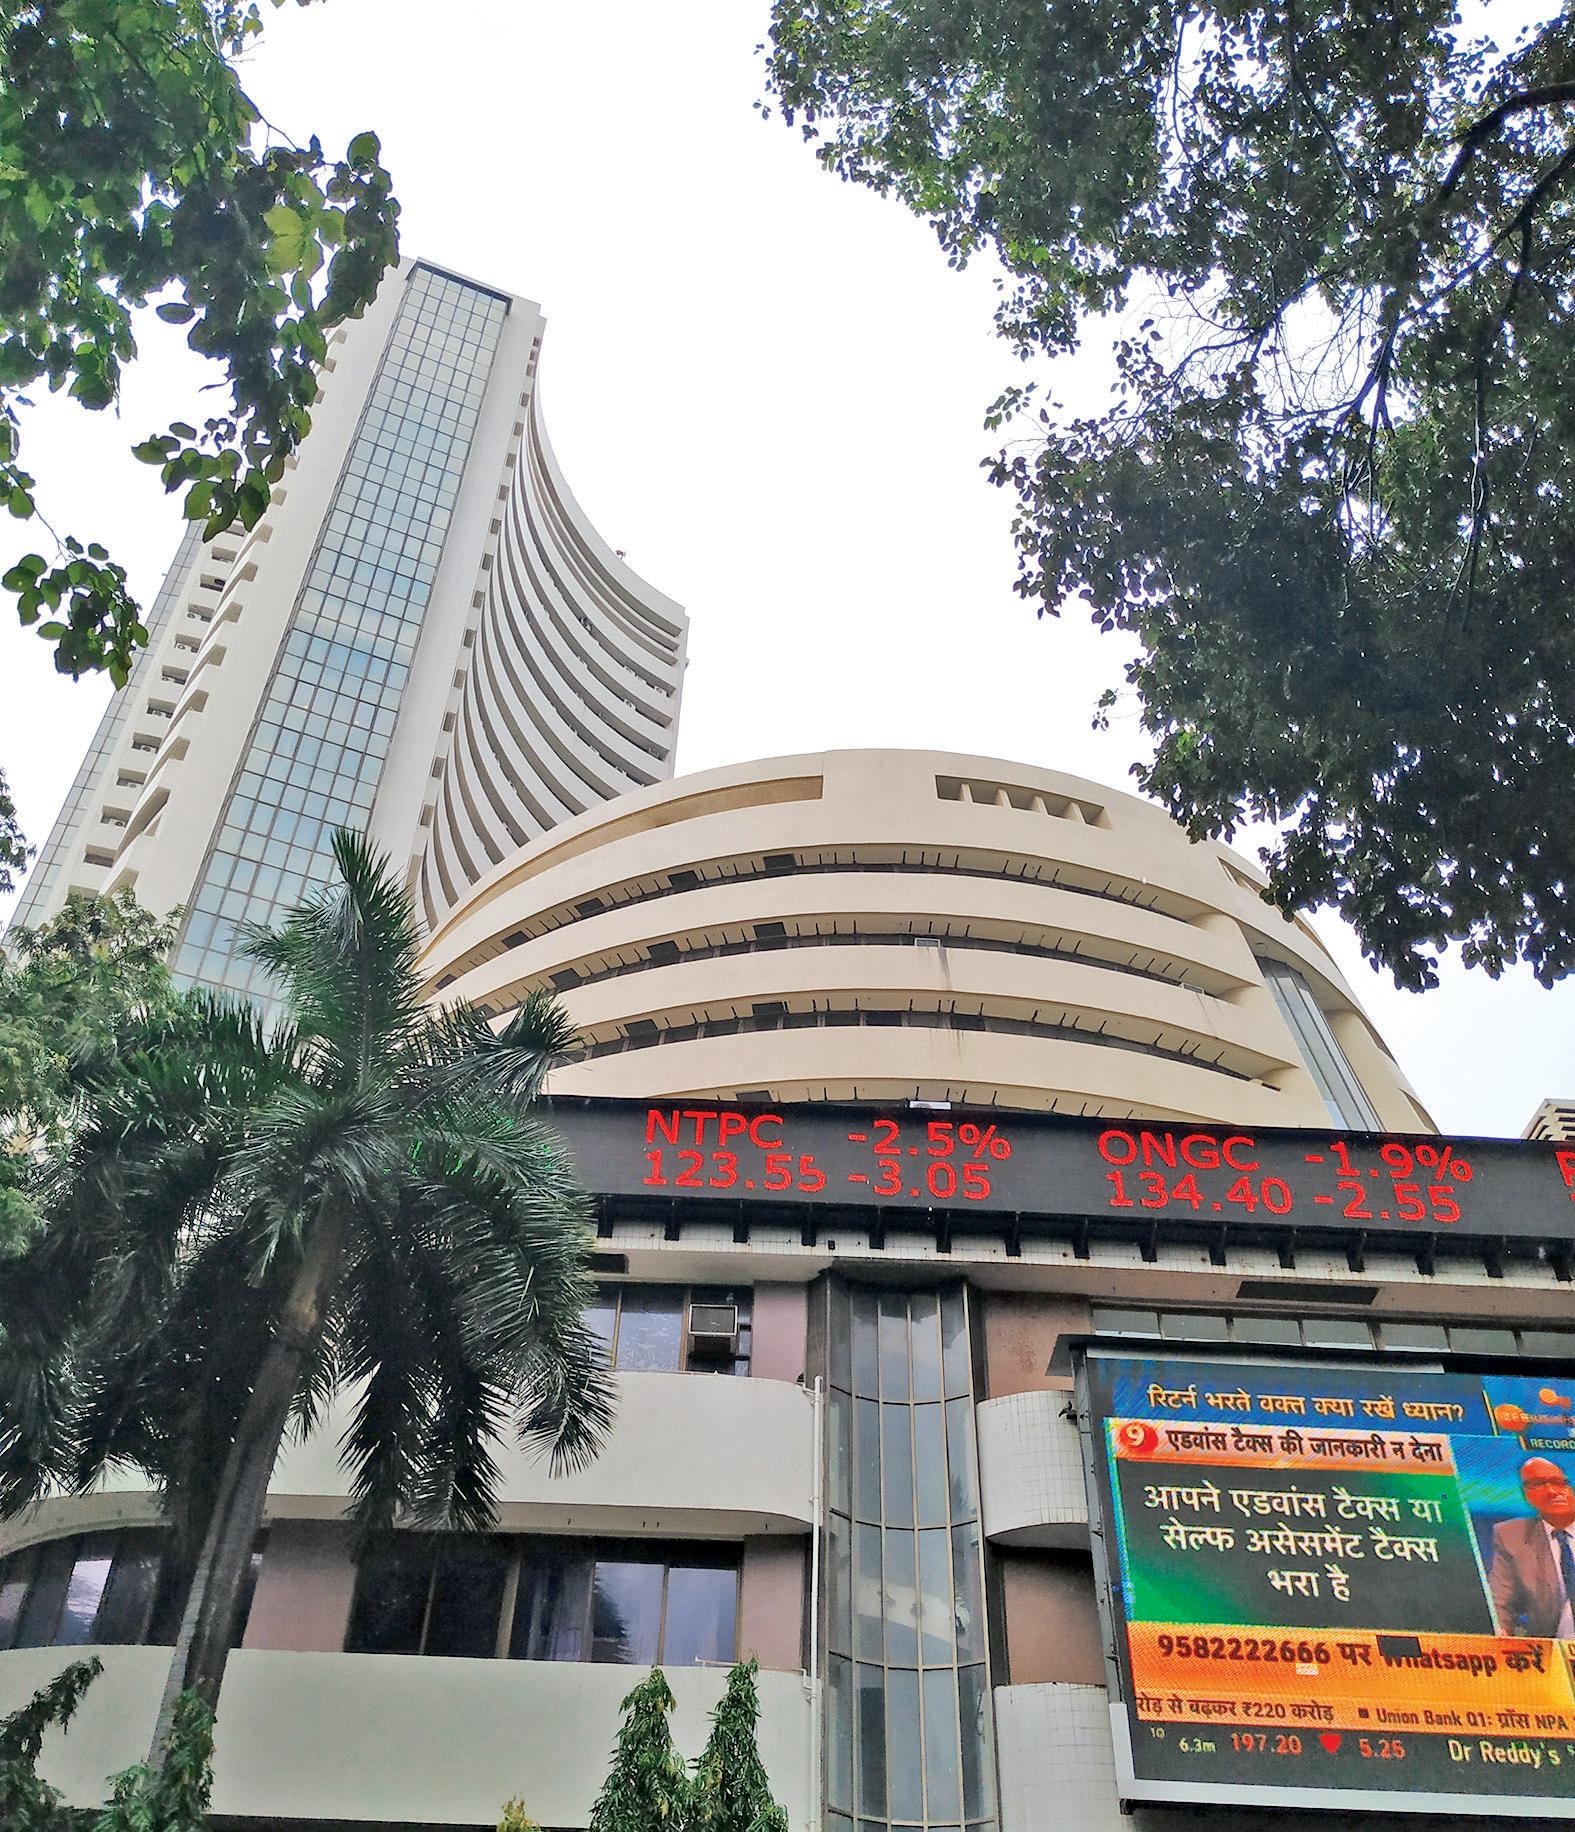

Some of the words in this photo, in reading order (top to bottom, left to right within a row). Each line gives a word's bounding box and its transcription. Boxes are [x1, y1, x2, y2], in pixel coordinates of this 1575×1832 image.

[646, 1109, 784, 1150] NTPC
[848, 1119, 1012, 1161] -2.5%
[1097, 1130, 1262, 1172] ONGC
[1304, 1140, 1473, 1182] -1.9%
[643, 1150, 828, 1193] 123.55
[848, 1159, 992, 1200] -3.05
[1105, 1170, 1293, 1215] 134.40
[1313, 1180, 1462, 1223] -2.55
[1147, 1384, 1198, 1409] रिटर्न
[1204, 1388, 1252, 1413] भरते
[1257, 1394, 1306, 1415] वक्त
[1311, 1397, 1355, 1418] क्या
[1361, 1395, 1396, 1420] रखें
[1402, 1402, 1465, 1423] ध्यान?
[1126, 1424, 1146, 1447] 9
[1165, 1426, 1227, 1452] एडवांस
[1230, 1427, 1274, 1455] टैक्स
[1279, 1430, 1304, 1456] की
[1309, 1432, 1386, 1460] जानकारी
[1391, 1440, 1406, 1461] न
[1410, 1436, 1444, 1462] देना
[1143, 1479, 1222, 1514] आपने
[1227, 1485, 1327, 1518] एडवांस
[1331, 1486, 1401, 1521] टैक्स
[1407, 1498, 1444, 1524] या
[1159, 1516, 1236, 1551] सेल्फ
[1245, 1521, 1366, 1559] असेसमेंट
[1368, 1526, 1440, 1563] टैक्स
[1266, 1568, 1320, 1598] भरा
[1323, 1563, 1351, 1603] है
[1157, 1635, 1331, 1665] 9582222666
[1335, 1642, 1373, 1667] पर
[1500, 1643, 1546, 1674] करें
[1376, 1708, 1420, 1725] Union
[1423, 1709, 1462, 1727] Bank
[1535, 1713, 1569, 1731] NPA
[1447, 1739, 1472, 1763] Dr
[1479, 1740, 1562, 1770] Reddy's
